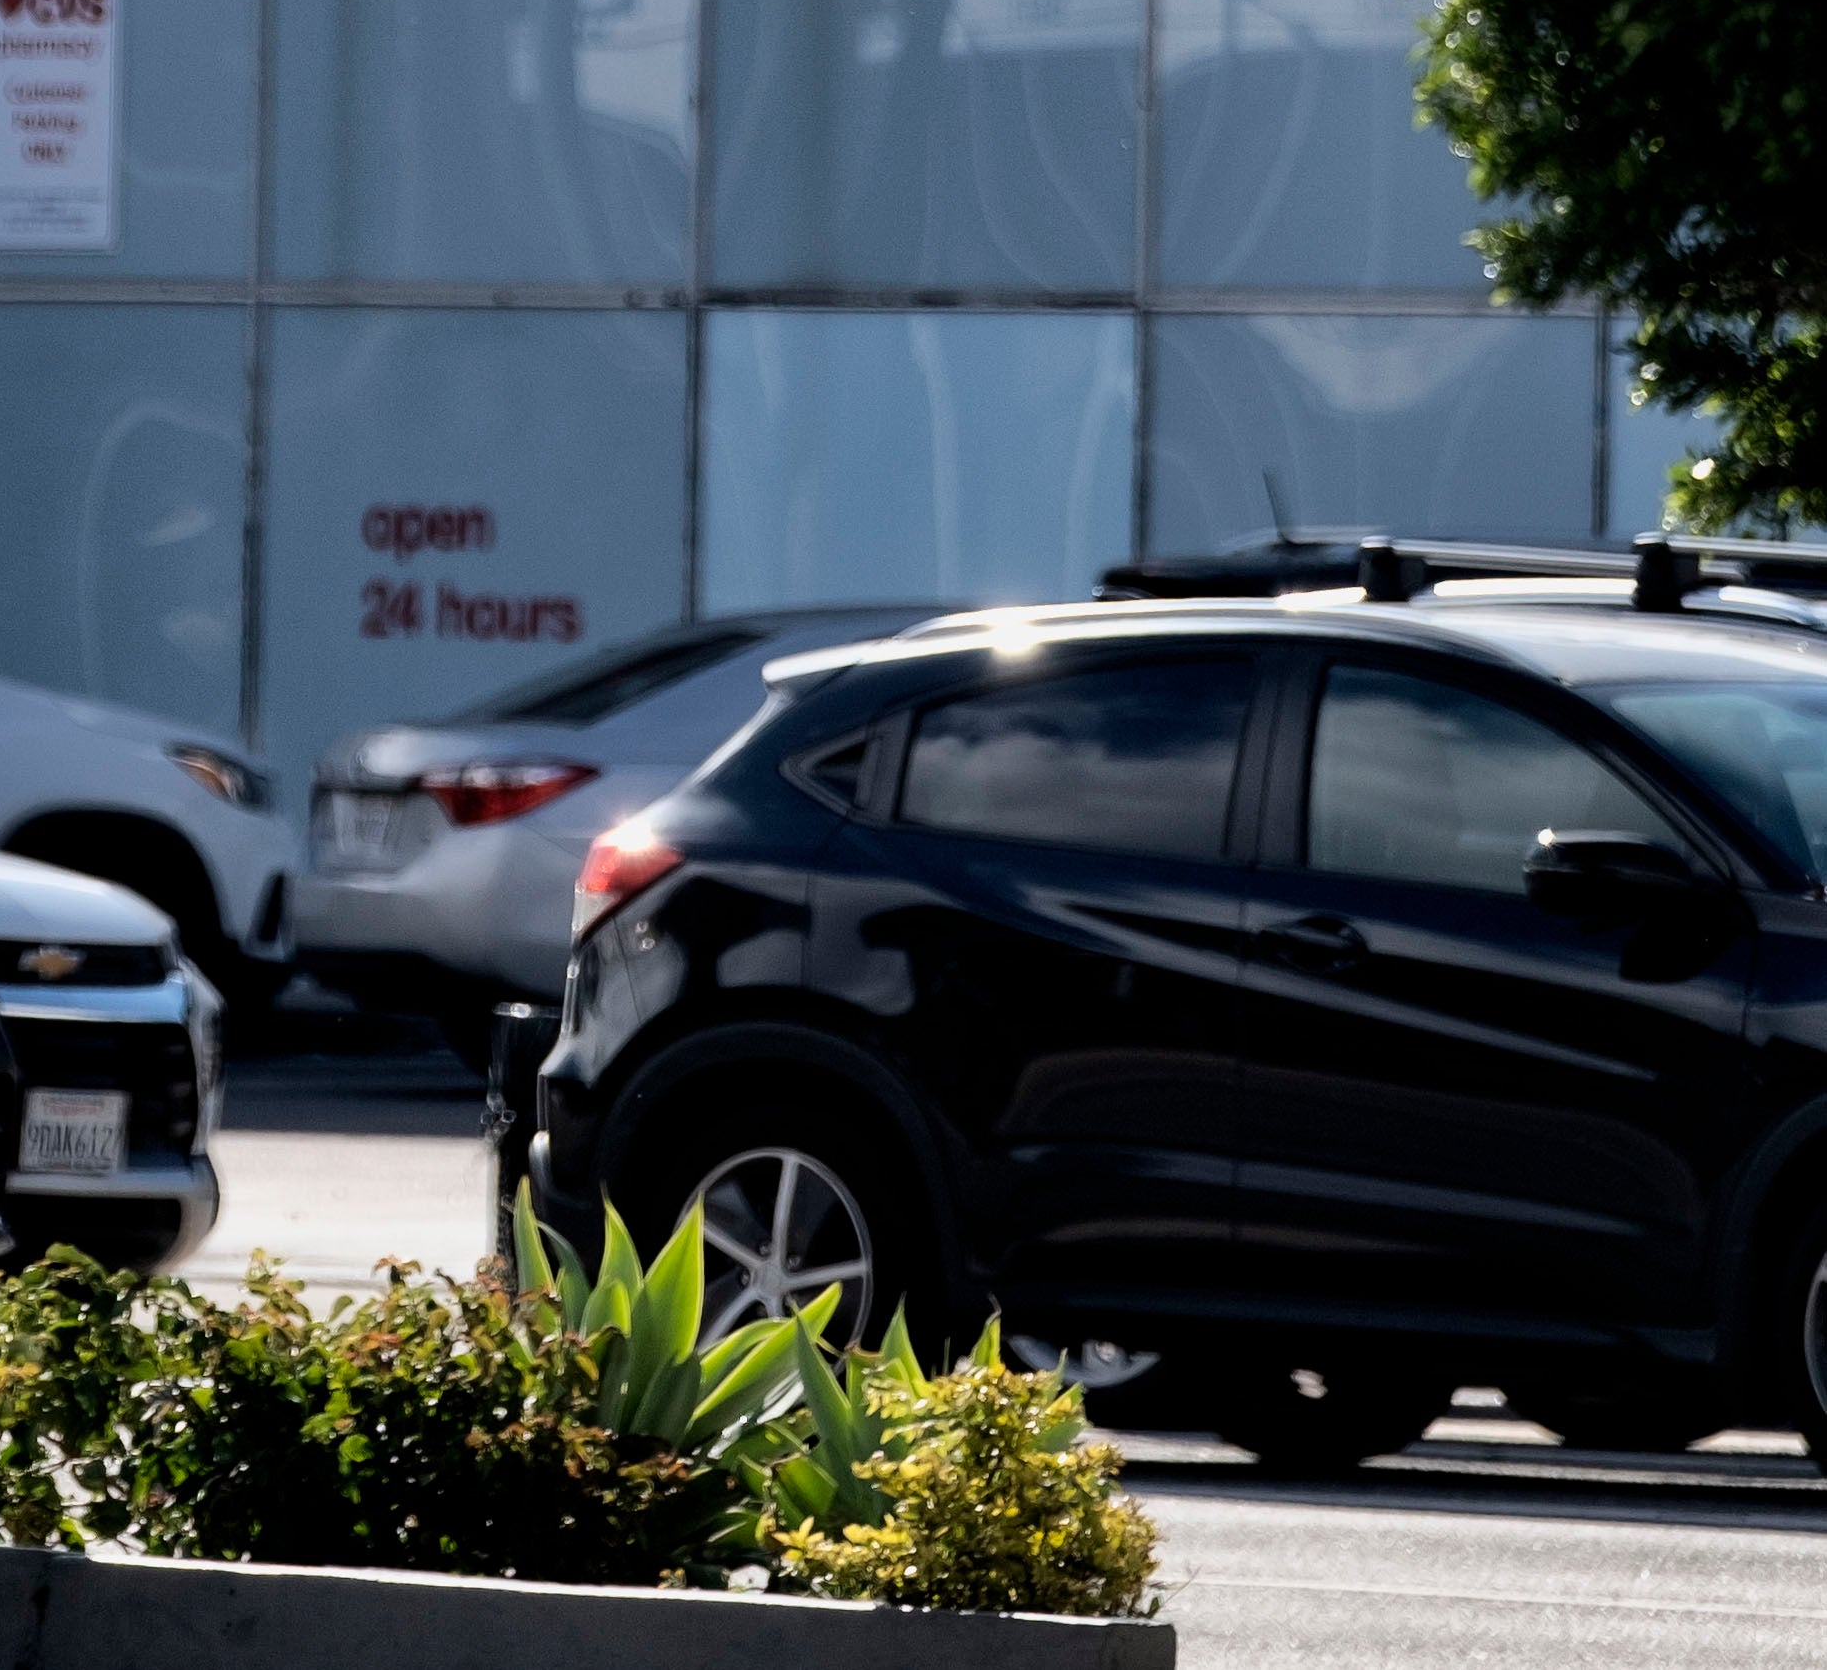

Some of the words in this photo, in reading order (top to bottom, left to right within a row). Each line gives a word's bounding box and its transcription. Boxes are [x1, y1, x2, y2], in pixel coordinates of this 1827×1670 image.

[362, 507, 493, 563] open
[361, 577, 421, 639] 24
[437, 581, 584, 642] hours
